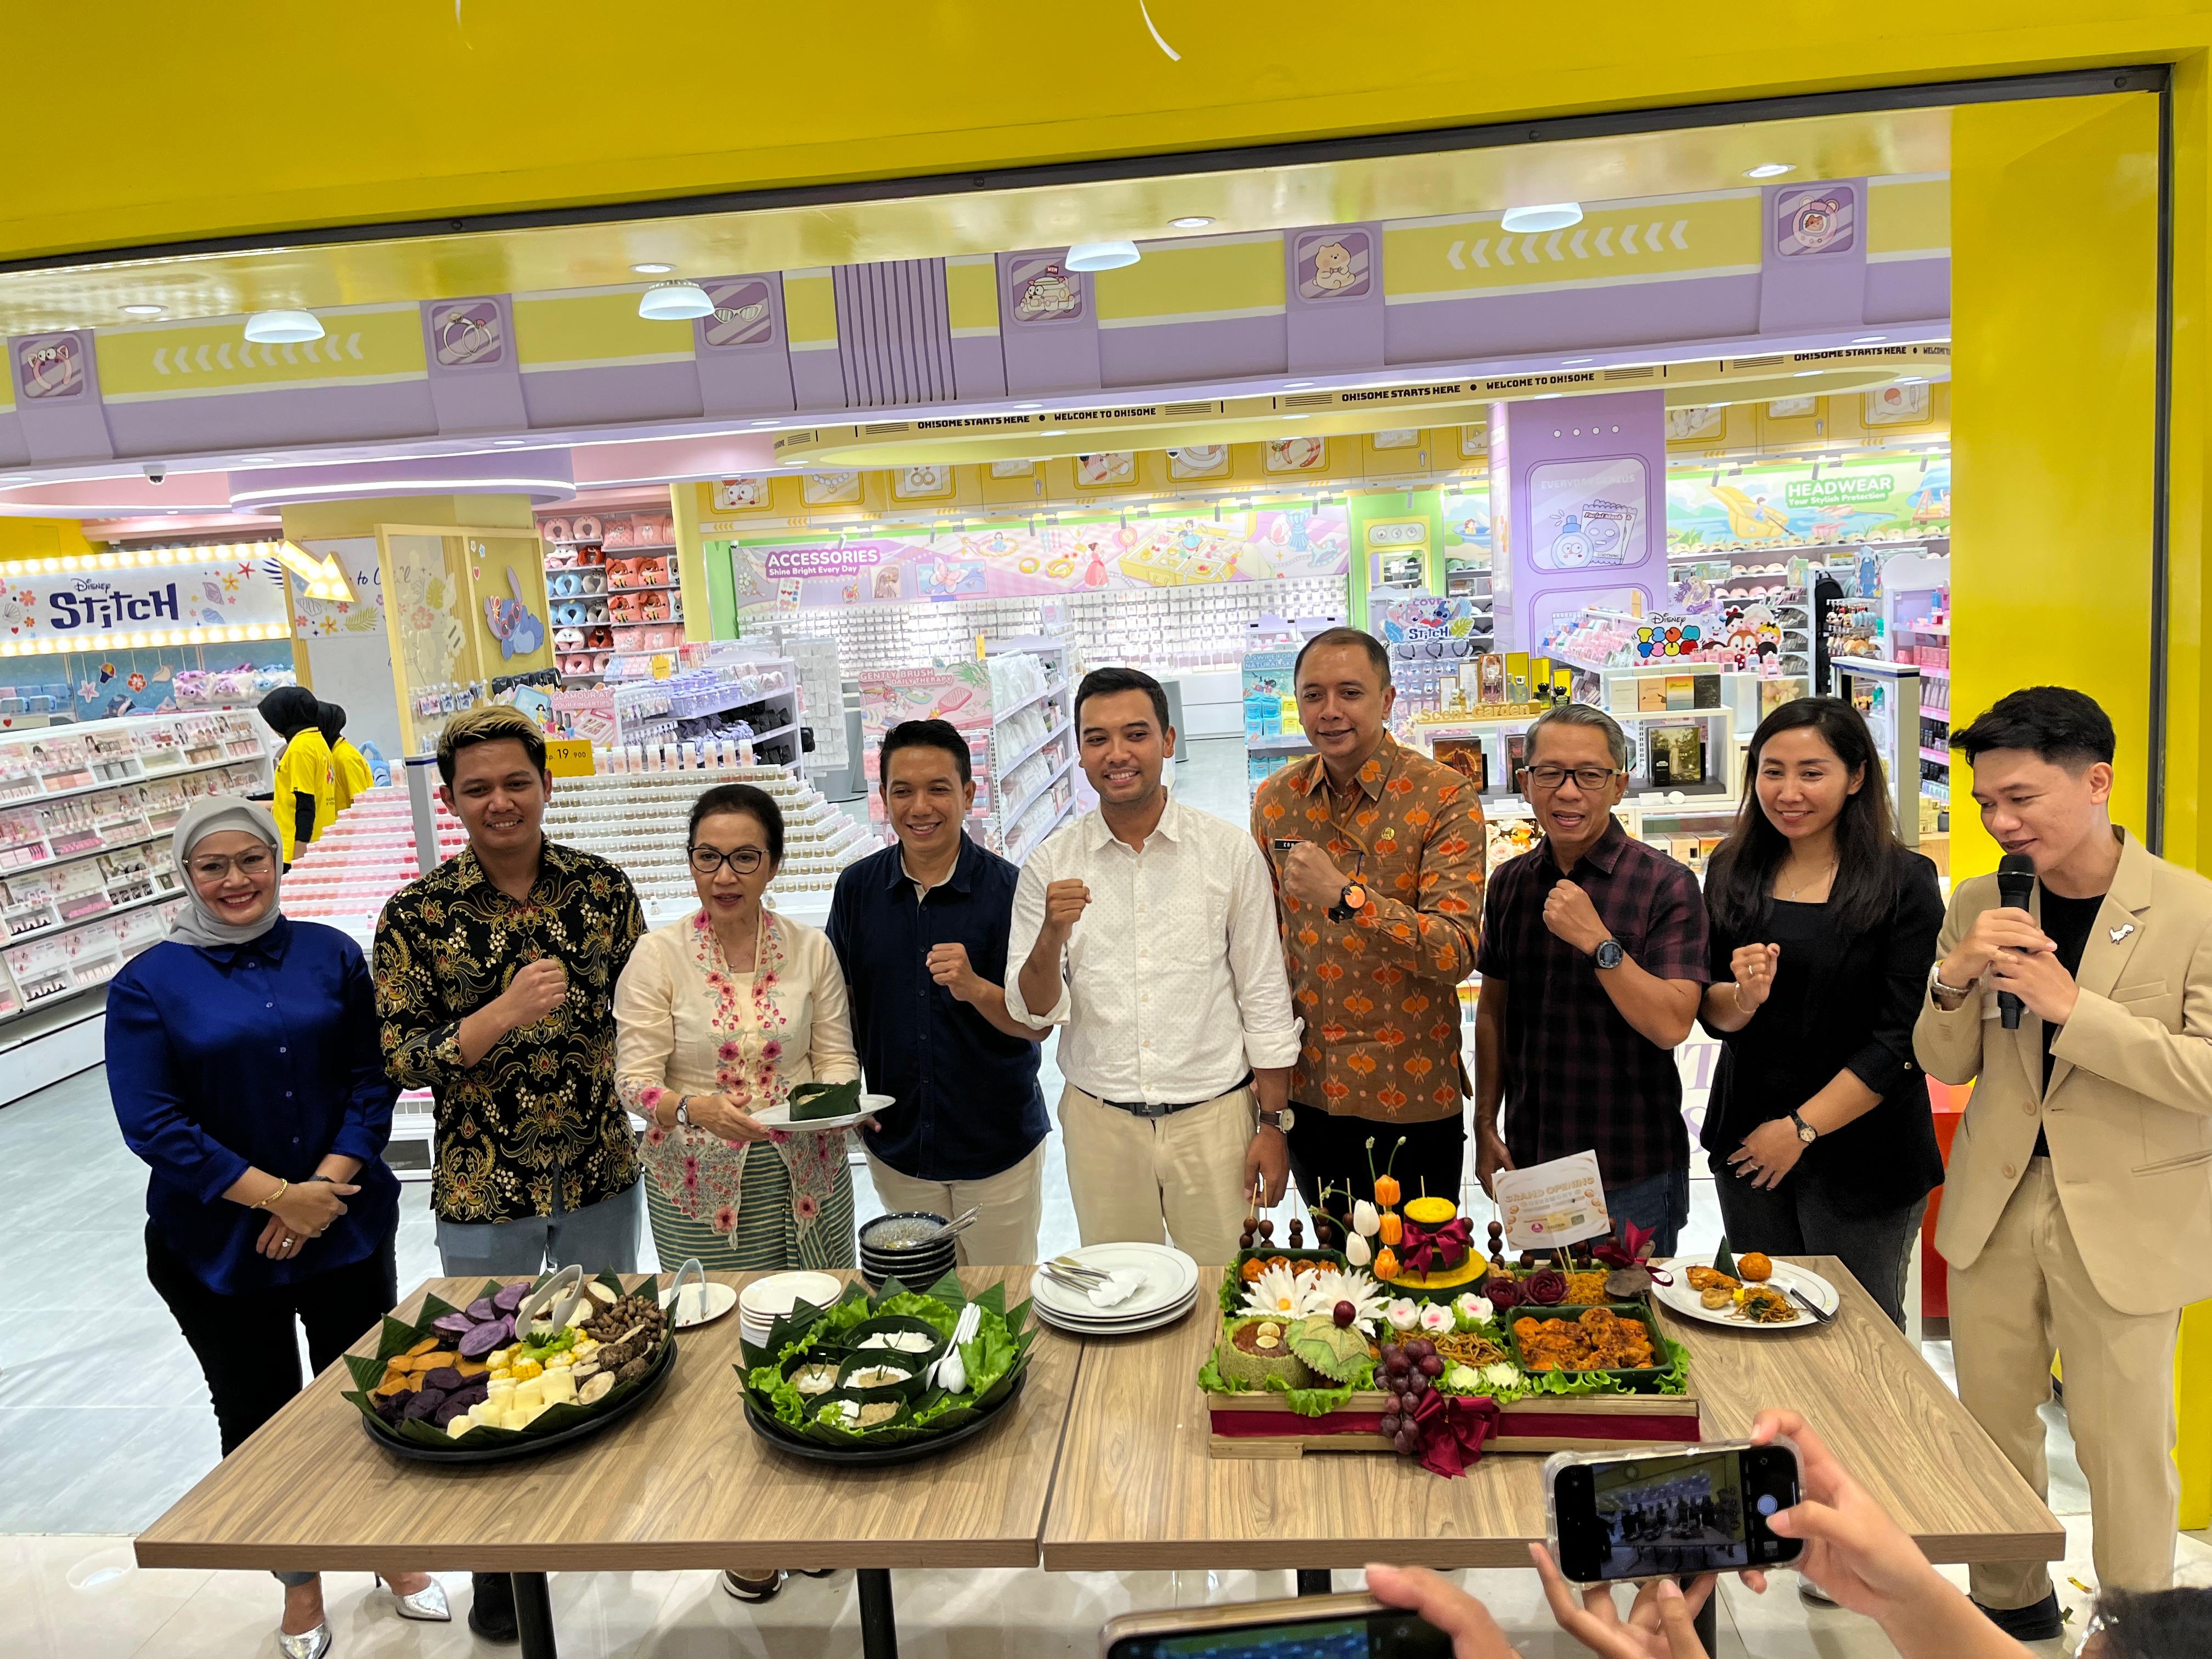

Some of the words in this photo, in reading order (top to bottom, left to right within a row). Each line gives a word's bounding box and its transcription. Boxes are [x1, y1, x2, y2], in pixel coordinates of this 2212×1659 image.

[1794, 350, 1843, 361] OH!SOME
[1846, 347, 1883, 356] STARTS
[1487, 378, 1533, 390] WELCOME
[1550, 374, 1594, 384] OH!SOME
[1342, 391, 1389, 402] OH!SOME
[1391, 388, 1431, 398] STARTS
[1432, 385, 1460, 395] HERE
[1054, 411, 1098, 420] WELCOME
[1114, 408, 1156, 417] OH!SOME
[918, 419, 962, 429] OH!SOME
[964, 416, 1002, 426] STARTS
[1004, 415, 1030, 424] HERE
[1788, 477, 1891, 497] HEADWEAR
[1811, 495, 1839, 505] Stylish
[1842, 492, 1886, 501] Protection
[768, 549, 878, 567] ACCESSORIES
[792, 567, 816, 575] Bright
[818, 566, 839, 574] Every
[357, 571, 368, 585] to
[1245, 661, 1279, 669] NATURAL
[860, 670, 896, 681] GENTLY
[900, 668, 934, 678] BRUSH
[916, 675, 952, 684] THERAPY
[552, 692, 596, 701] GLAMOUR
[1421, 707, 1466, 721] Scent
[1471, 704, 1530, 718] Garden
[1505, 1189, 1544, 1203] GRAND
[1545, 1176, 1595, 1195] OPENING
